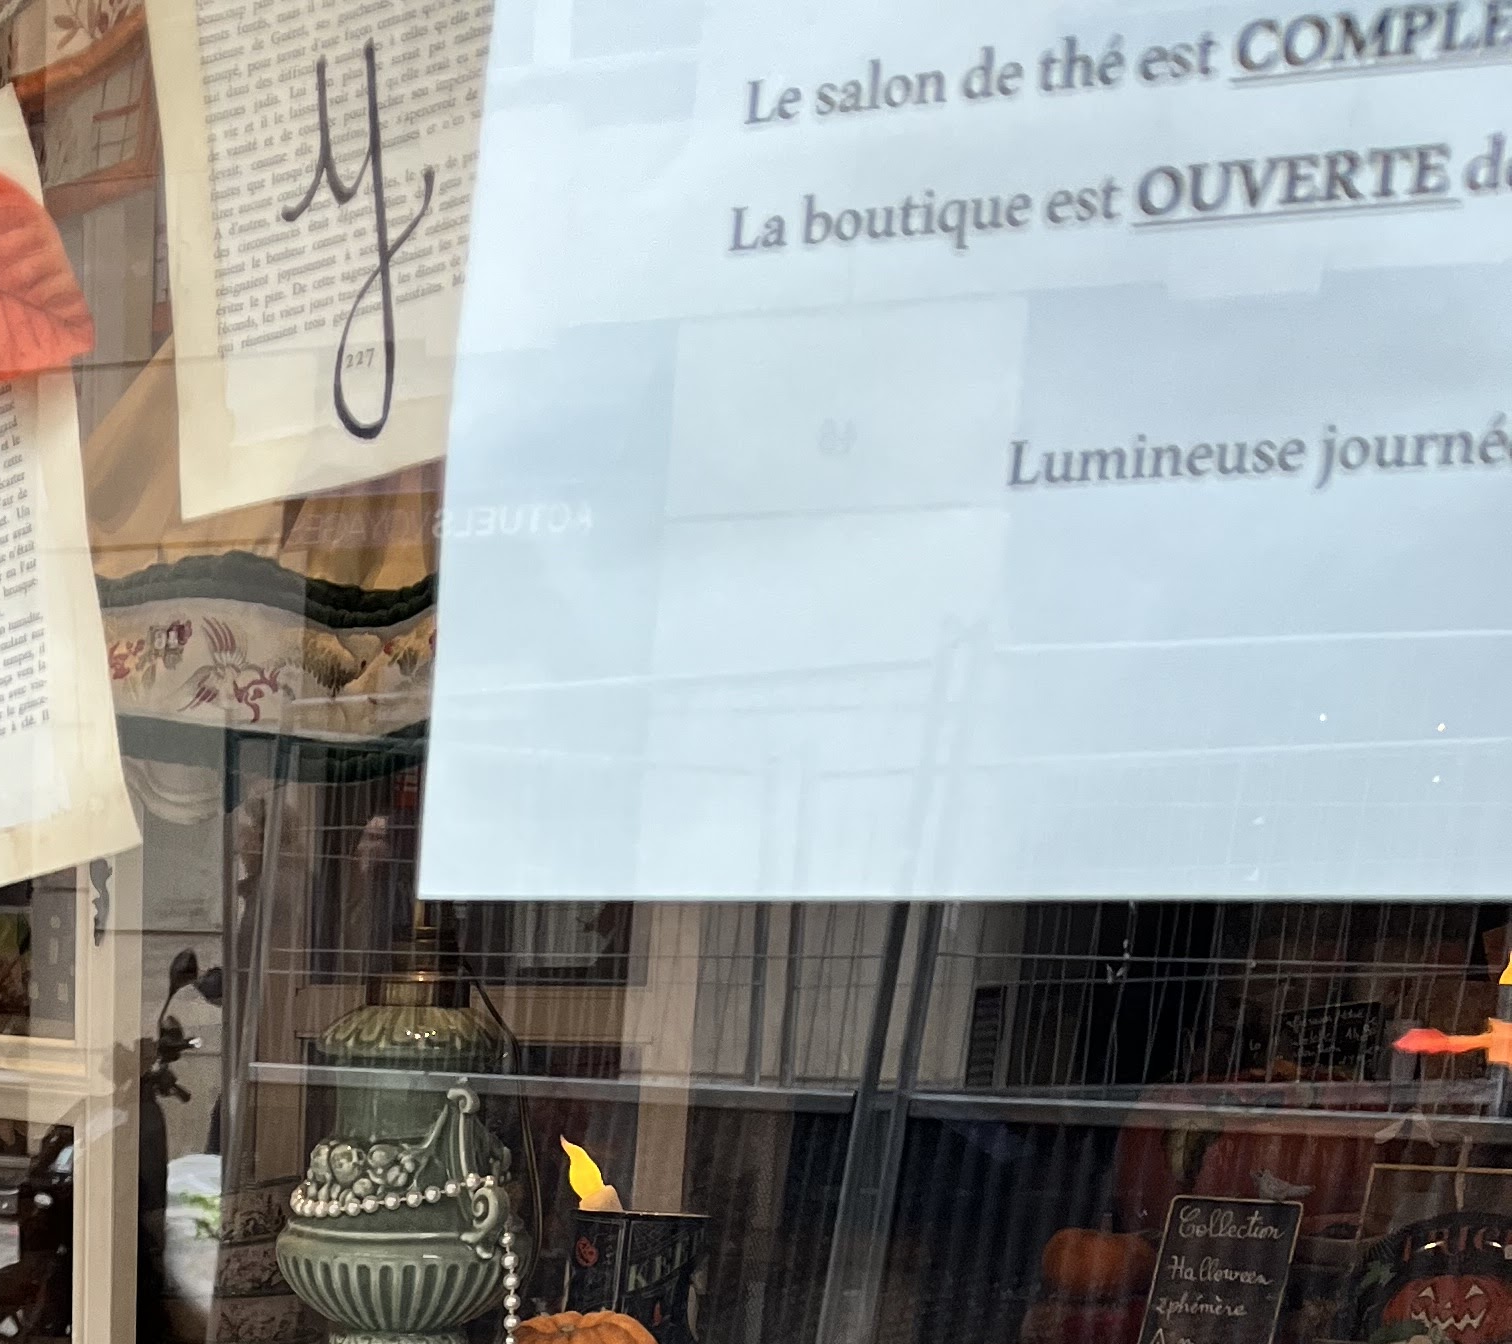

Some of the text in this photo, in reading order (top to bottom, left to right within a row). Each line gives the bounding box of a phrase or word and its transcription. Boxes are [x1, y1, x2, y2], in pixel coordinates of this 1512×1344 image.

[745, 0, 1512, 126] Le salon de thé est COMPLE
[729, 131, 1512, 256] La boutique est OUVERTE d
[346, 348, 375, 368] 227
[1008, 413, 1512, 488] Lumineuse journé
[1179, 1205, 1285, 1240] Collection
[1168, 1255, 1275, 1285] Halloween
